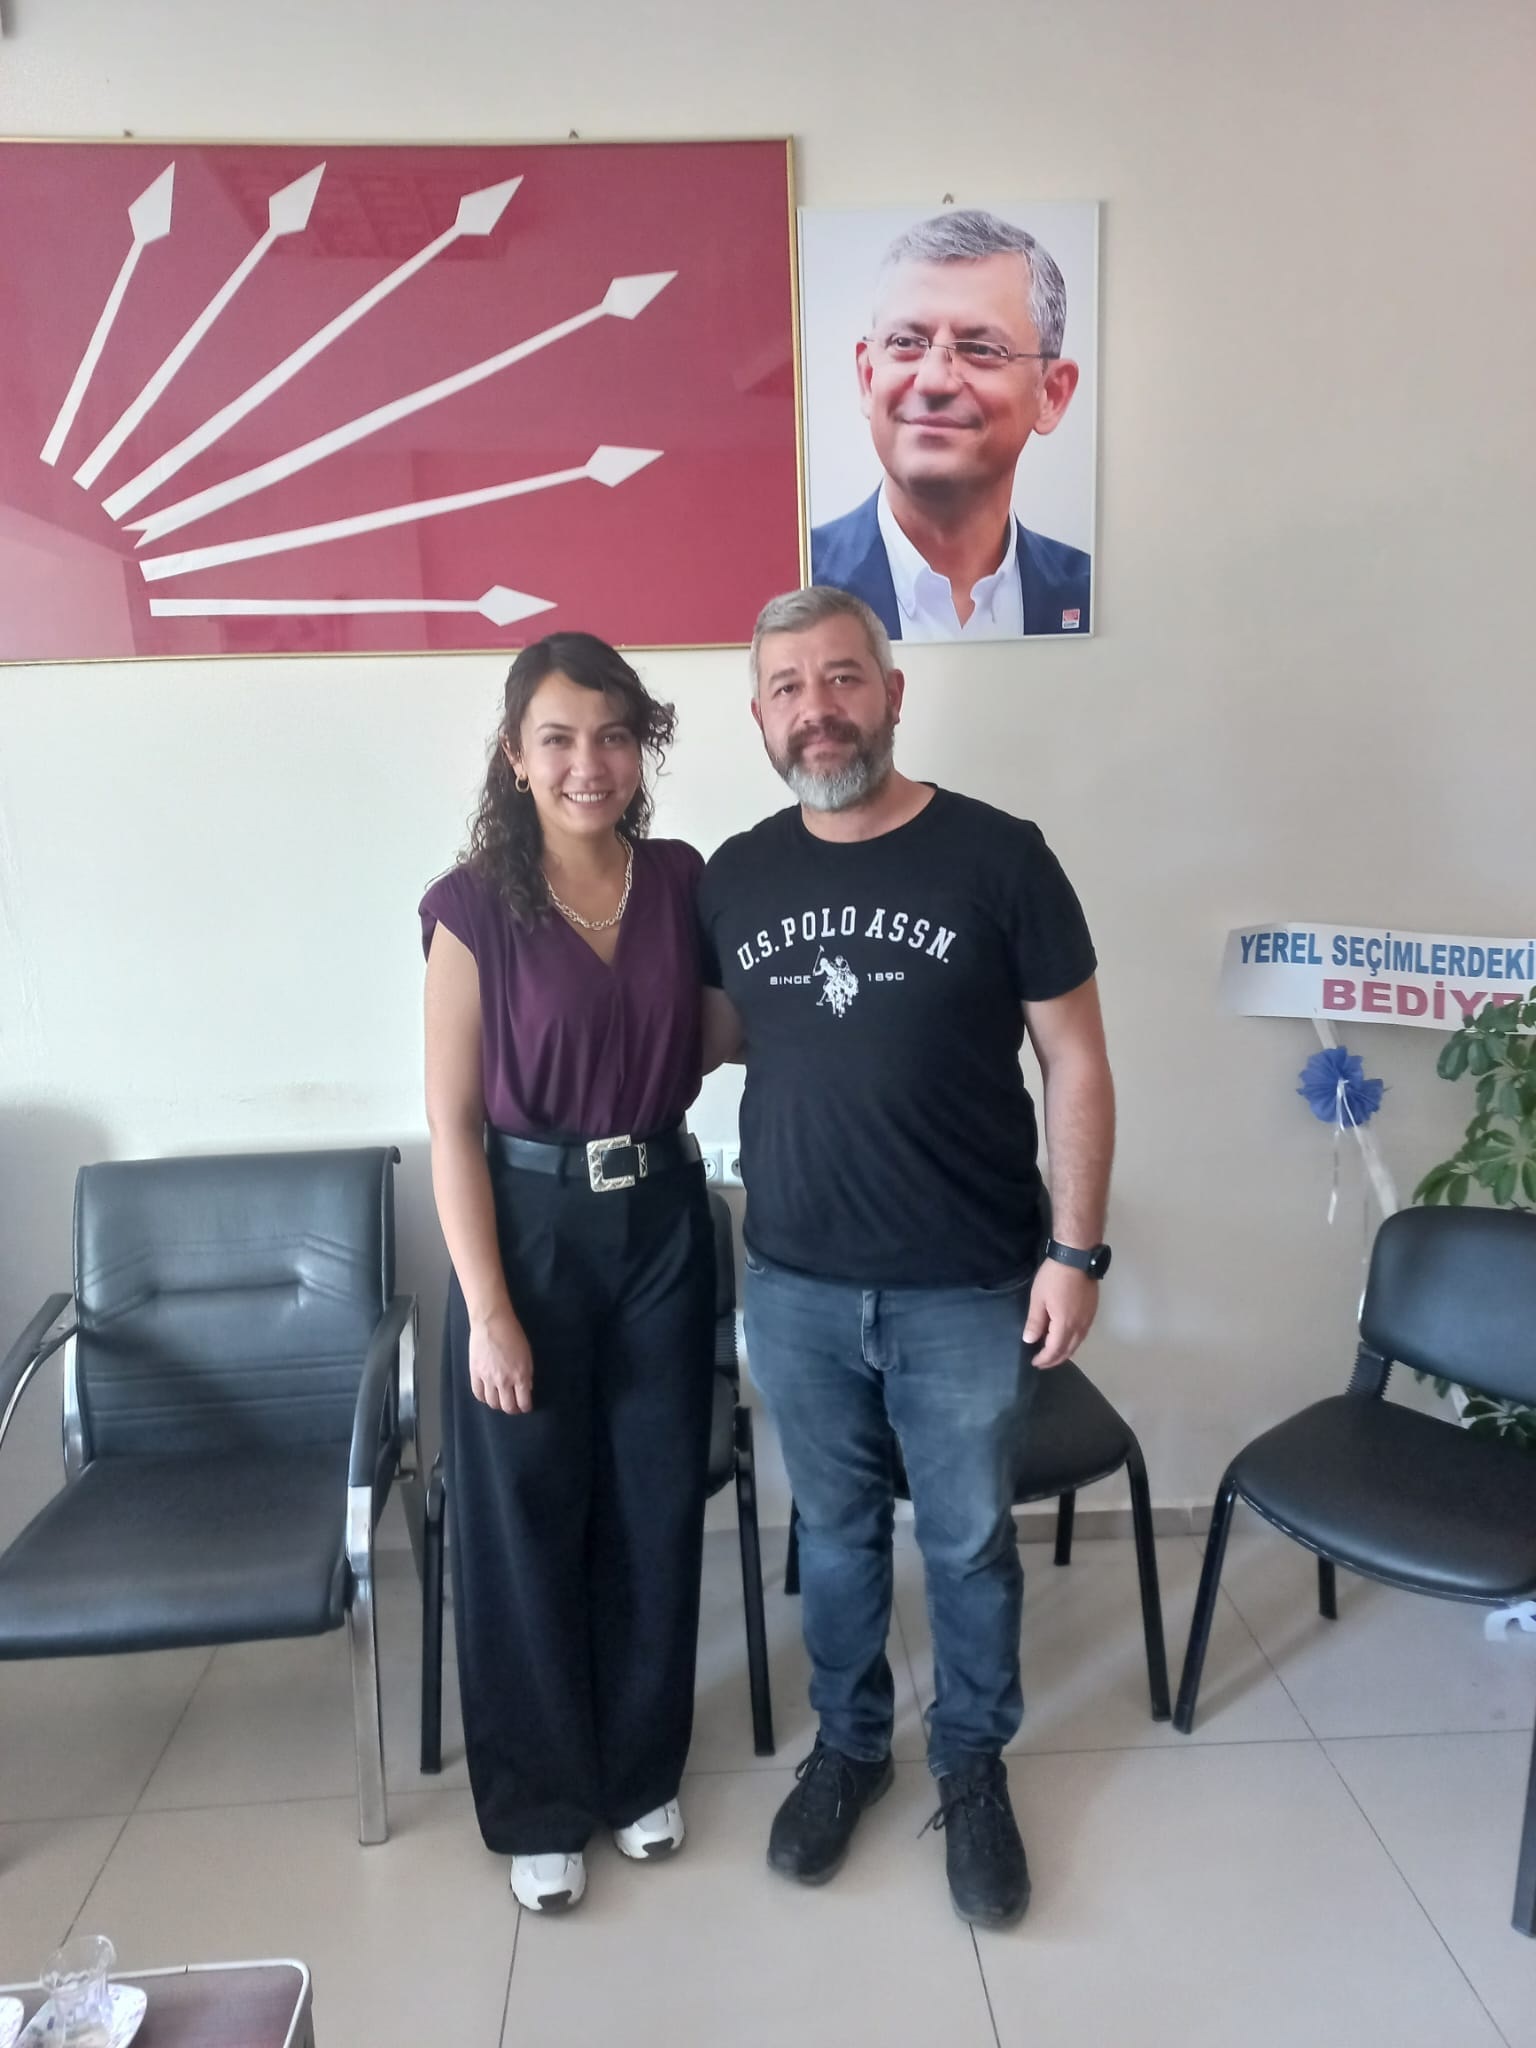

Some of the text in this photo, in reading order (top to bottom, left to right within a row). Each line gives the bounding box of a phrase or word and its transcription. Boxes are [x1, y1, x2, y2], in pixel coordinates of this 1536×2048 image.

[737, 905, 957, 971] U.S. POLO ASSN.
[1240, 931, 1535, 980] YEREL SEÇİMLERDEKİ
[769, 971, 905, 986] SINCE 1890
